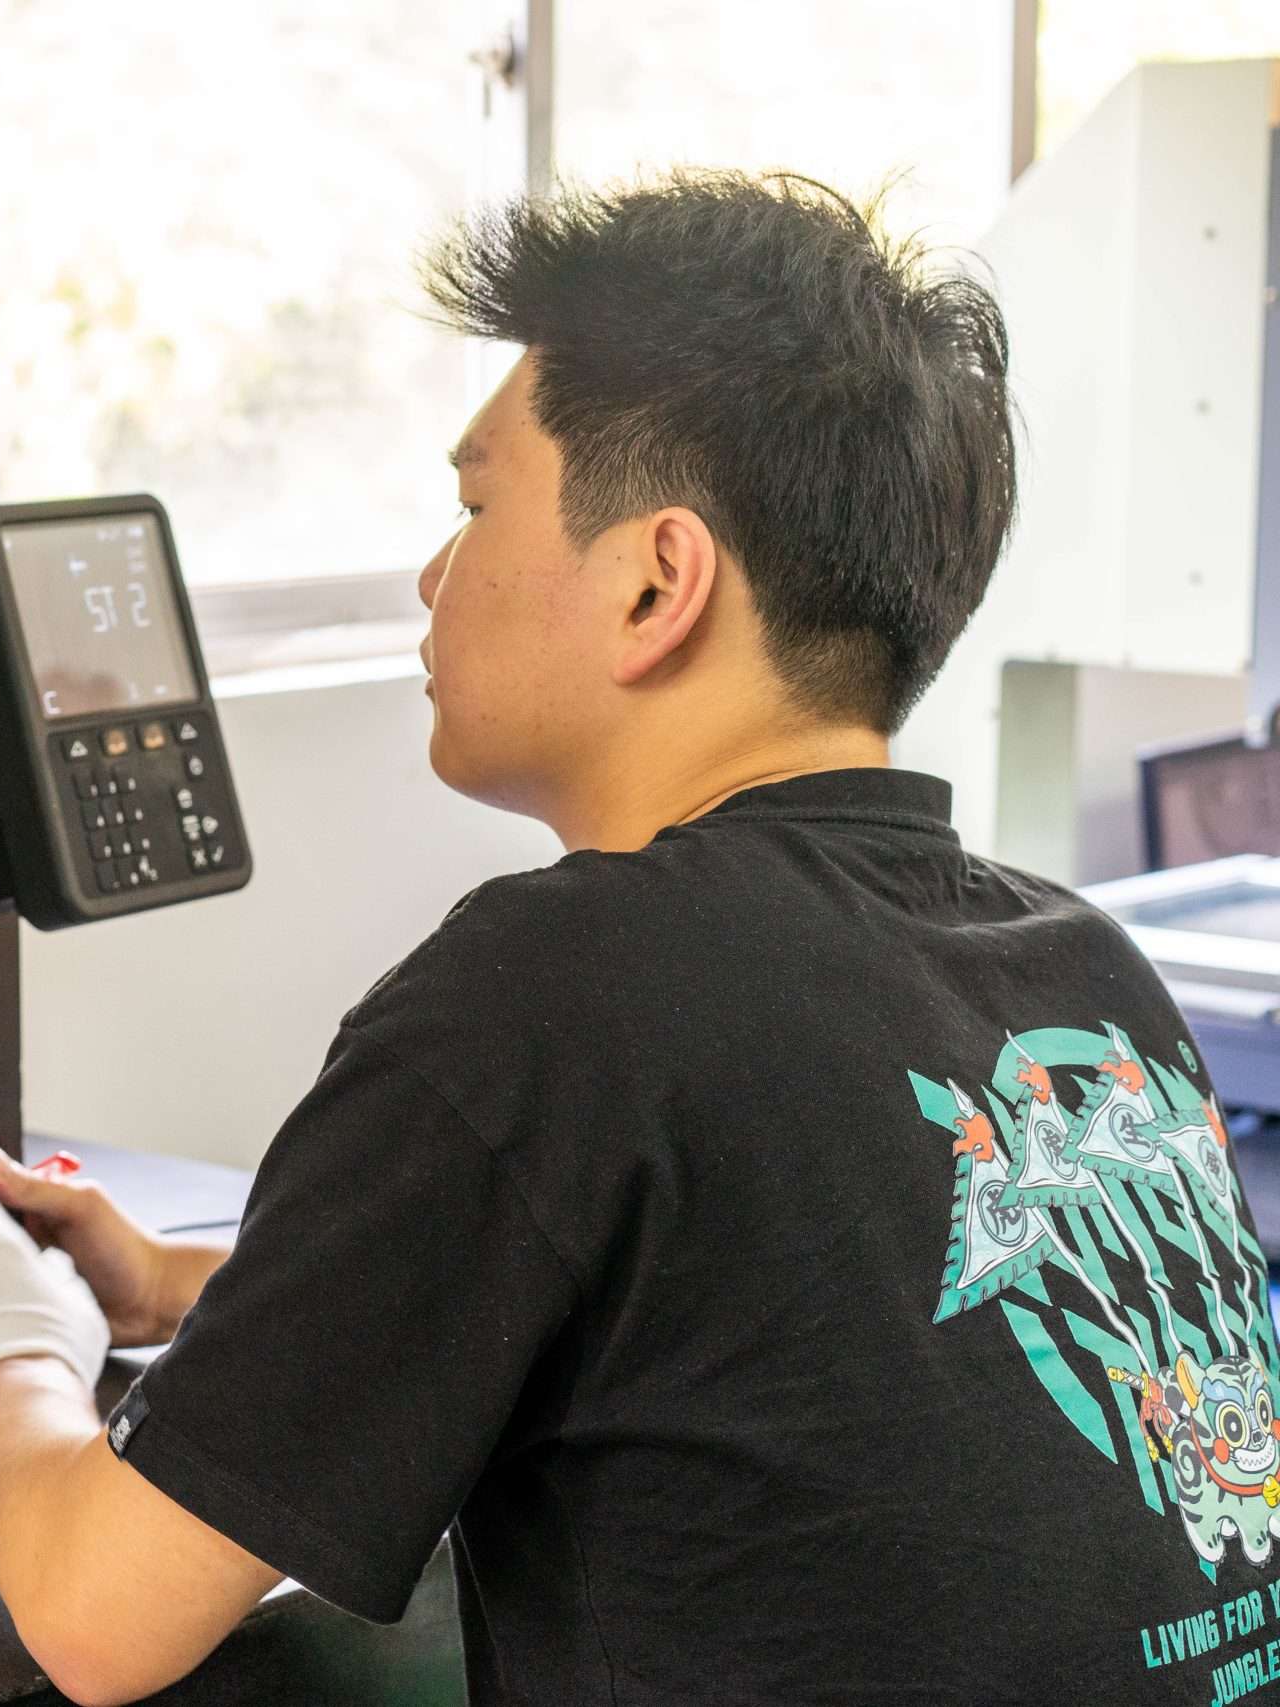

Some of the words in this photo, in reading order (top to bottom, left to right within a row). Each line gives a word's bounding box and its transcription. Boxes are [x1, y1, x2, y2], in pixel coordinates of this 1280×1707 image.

[1140, 1609, 1221, 1669] LIVING
[1222, 1589, 1266, 1642] FOR
[1211, 1639, 1280, 1707] JUNGLE
